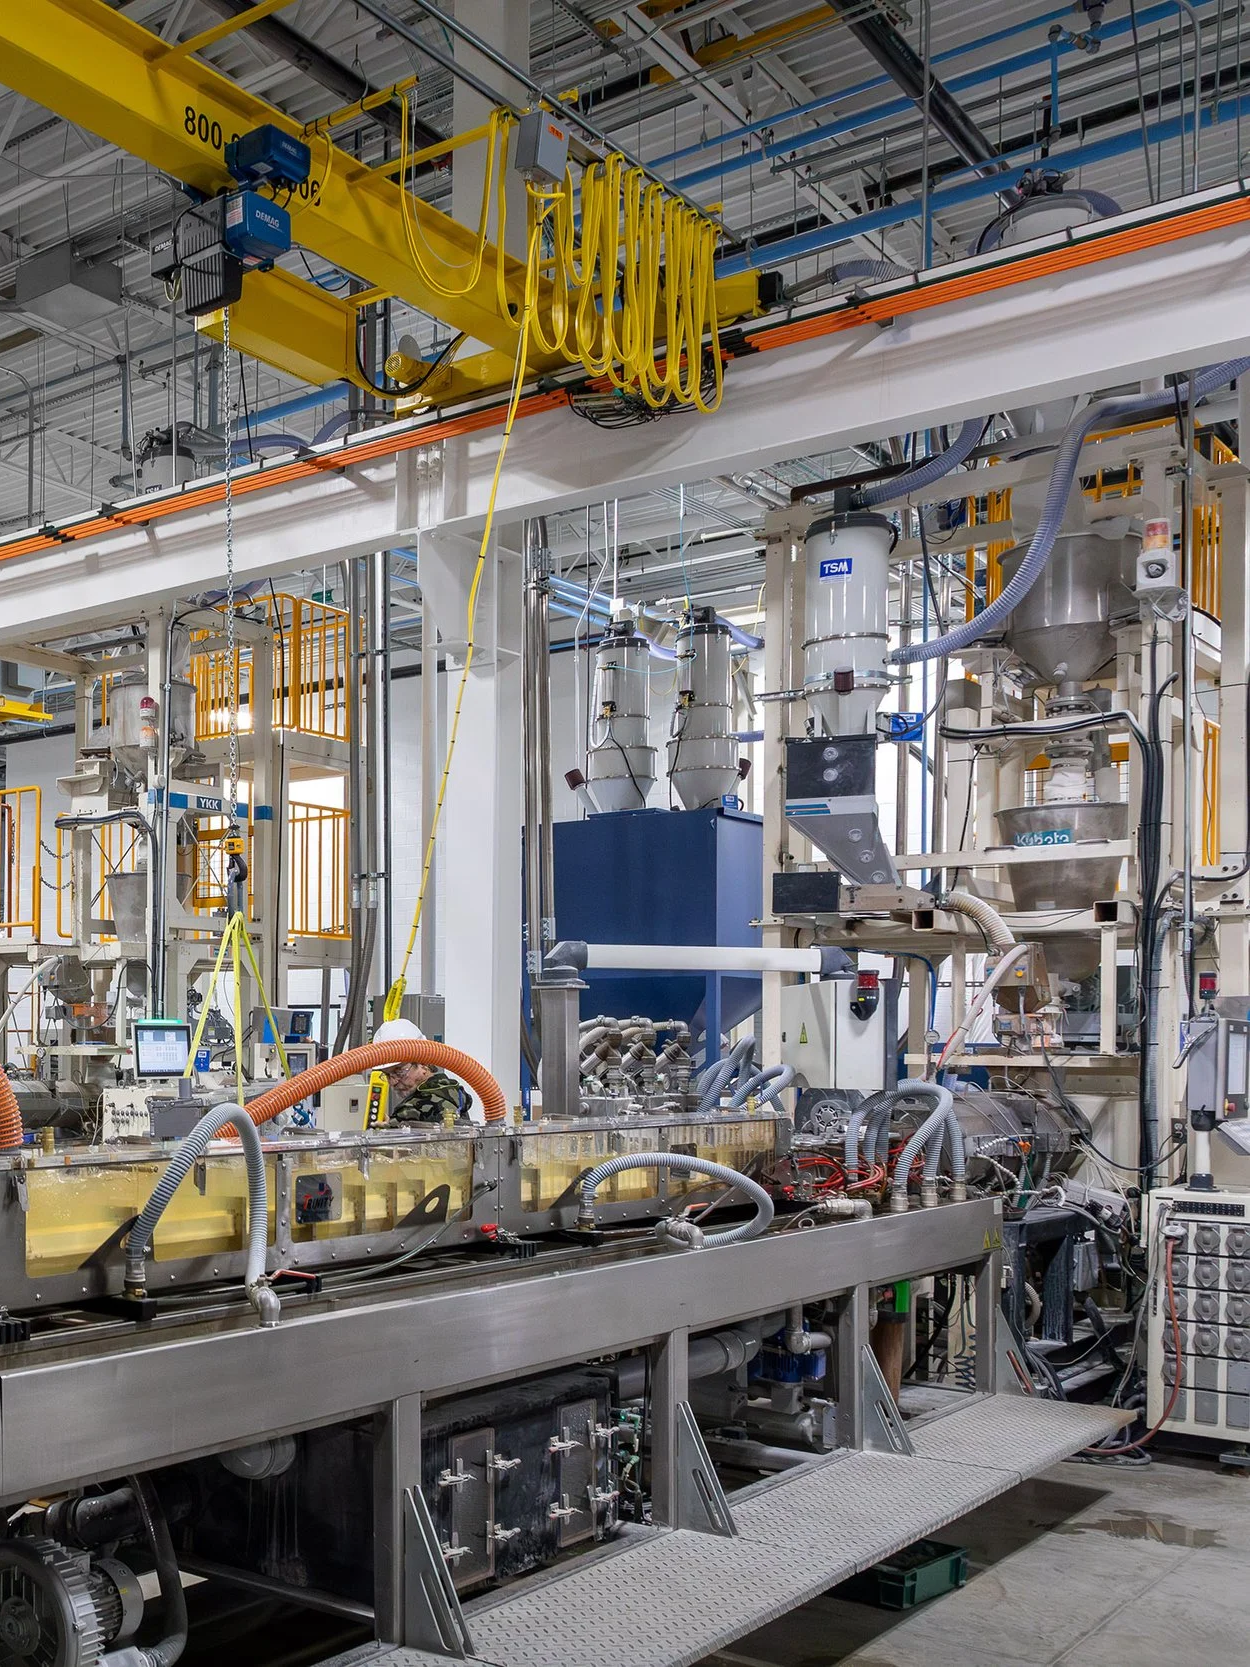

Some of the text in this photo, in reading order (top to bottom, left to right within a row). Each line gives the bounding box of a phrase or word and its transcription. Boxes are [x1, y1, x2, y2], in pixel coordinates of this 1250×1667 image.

[255, 209, 280, 228] DEMAG
[154, 239, 173, 252] DEMAG
[823, 561, 849, 574] TSM
[200, 798, 218, 810] YKK
[1016, 832, 1070, 846] Kubota
